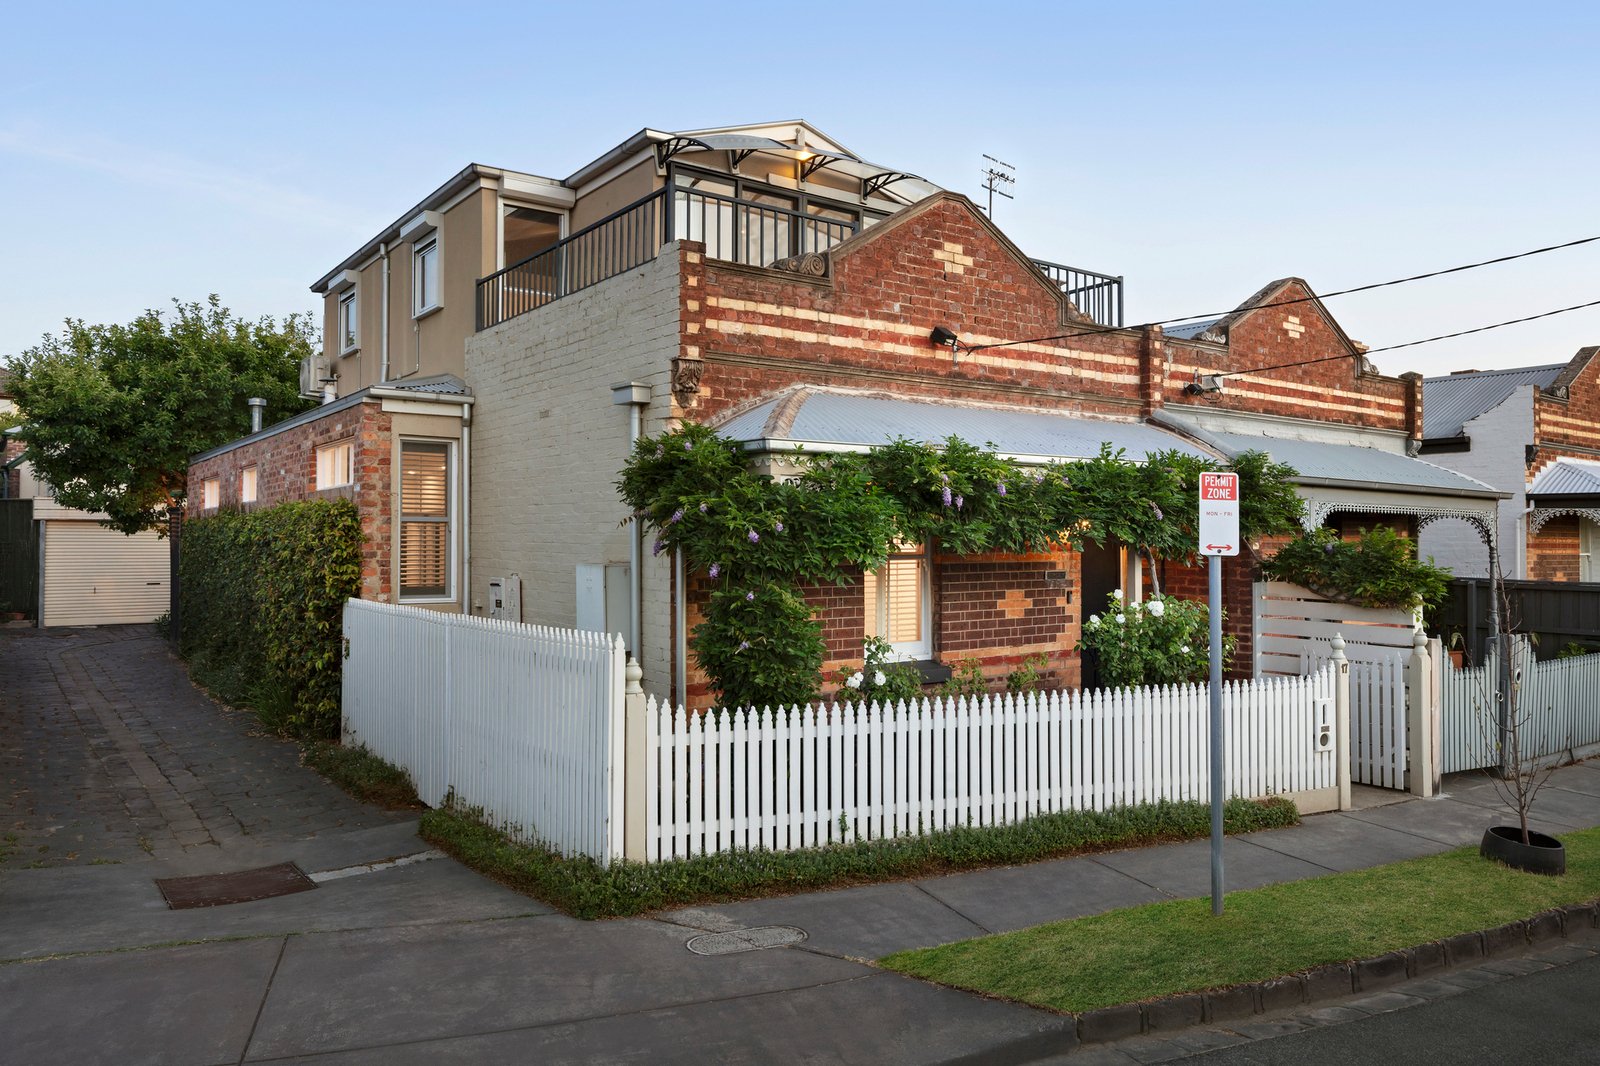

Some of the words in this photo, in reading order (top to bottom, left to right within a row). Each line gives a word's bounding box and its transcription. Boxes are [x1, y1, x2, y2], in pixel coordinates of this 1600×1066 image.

[1204, 475, 1233, 487] PERMIT
[1207, 488, 1231, 499] ZONE
[1341, 663, 1348, 674] 17
